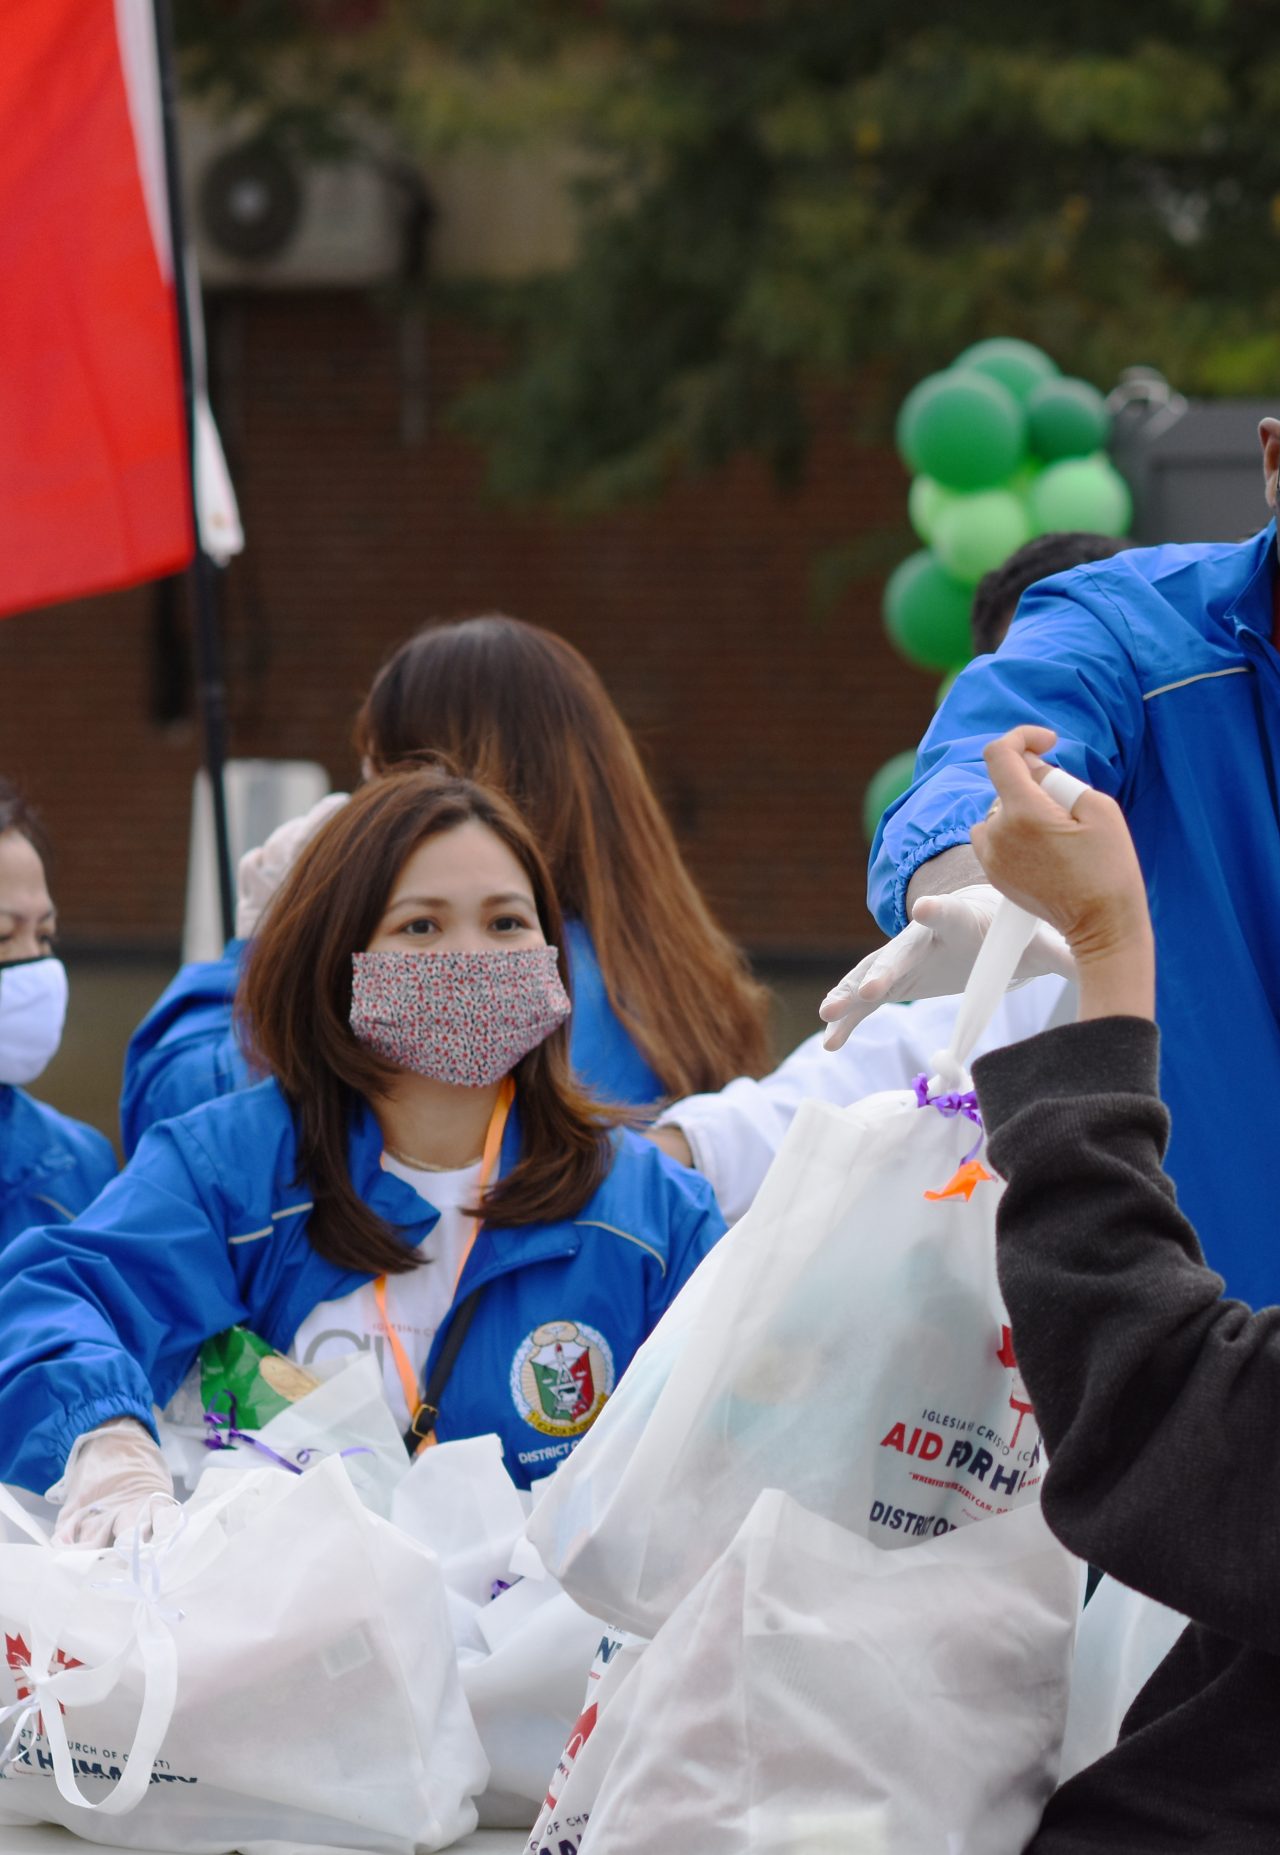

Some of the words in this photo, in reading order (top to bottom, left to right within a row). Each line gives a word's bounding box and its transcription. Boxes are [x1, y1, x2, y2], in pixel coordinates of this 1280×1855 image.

[976, 1425, 1010, 1456] CRISO
[518, 1442, 570, 1464] DISTRICT
[880, 1422, 944, 1462] AID
[989, 1463, 1026, 1495] H
[103, 1749, 117, 1759] OF
[546, 1821, 560, 1836] OF
